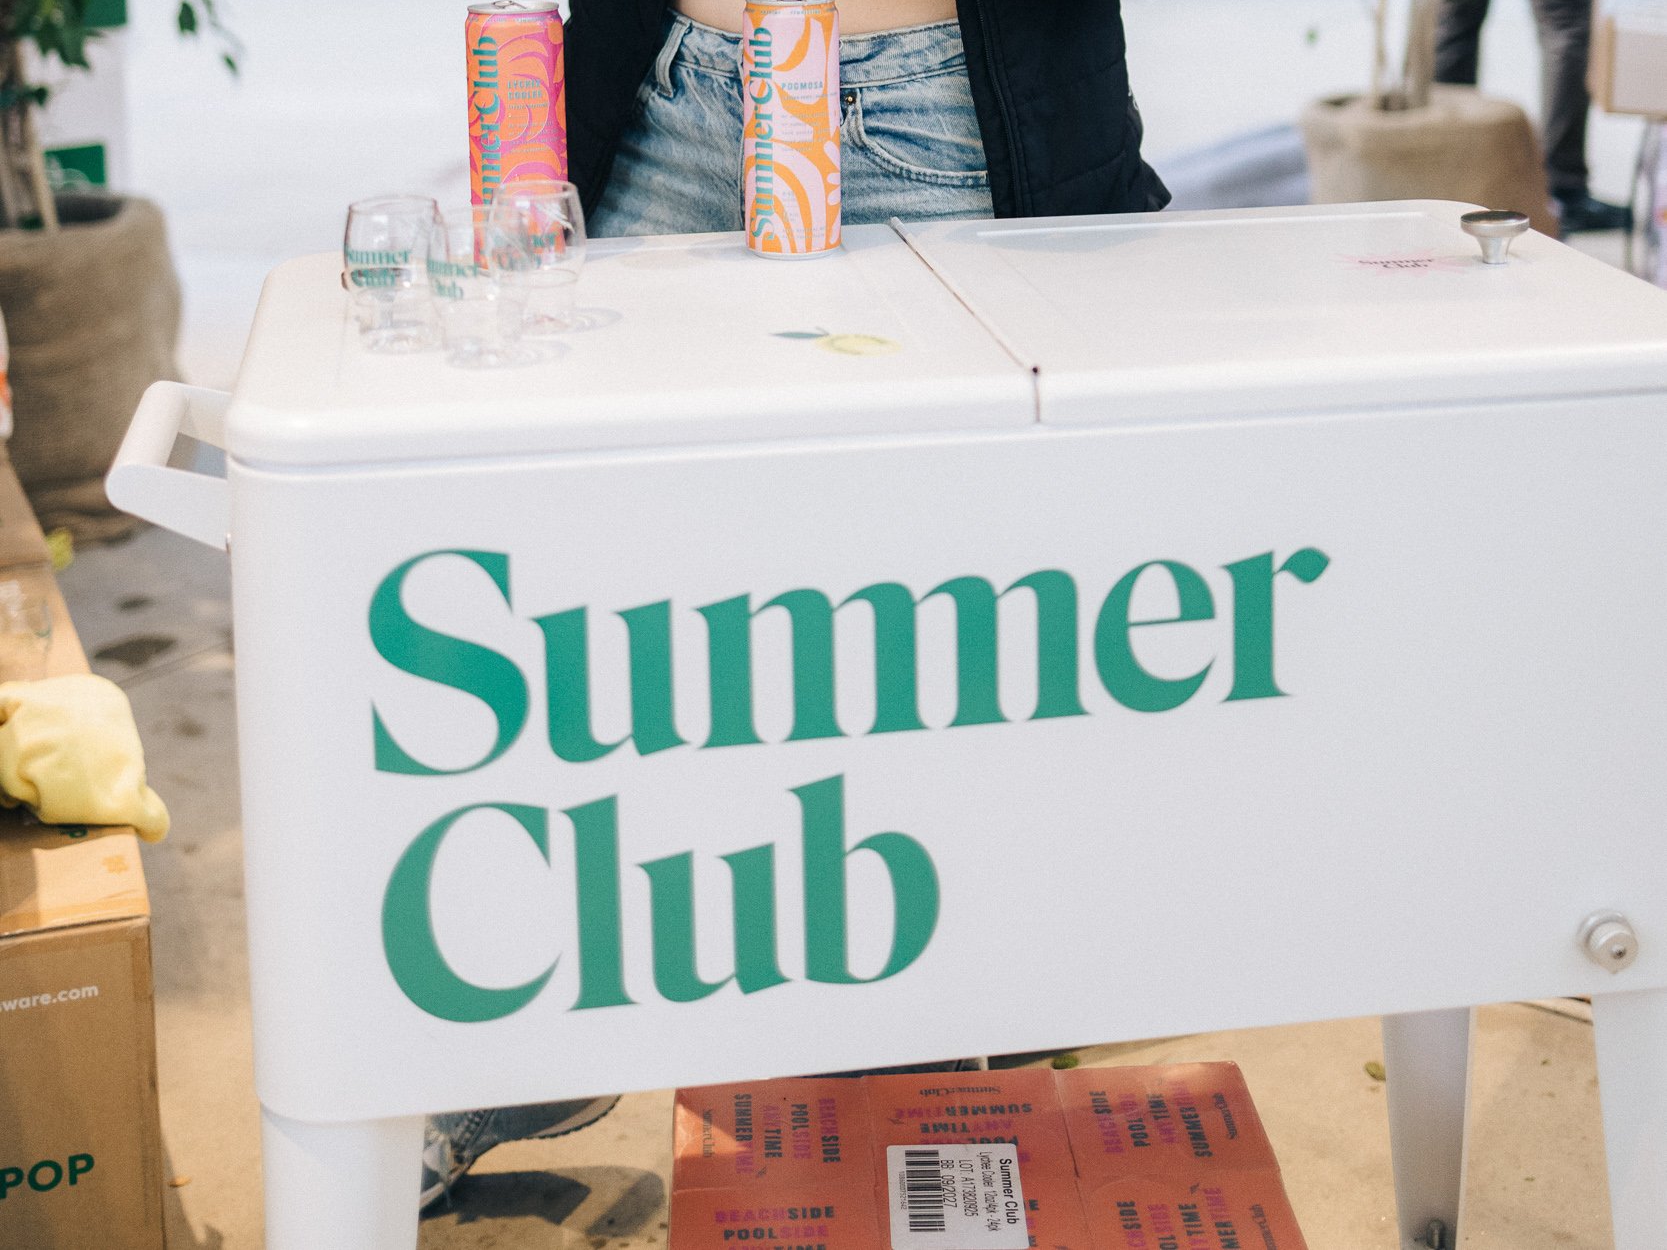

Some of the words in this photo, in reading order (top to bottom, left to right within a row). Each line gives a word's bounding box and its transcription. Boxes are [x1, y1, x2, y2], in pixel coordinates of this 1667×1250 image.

[780, 81, 824, 91] POGMOSA
[368, 546, 1331, 777] Summer
[381, 773, 941, 1024] Club
[0, 1153, 94, 1199] POP
[976, 1151, 993, 1170] Lychee
[982, 1170, 996, 1187] Cooler
[999, 1158, 1014, 1198] Summer
[941, 1175, 957, 1208] 09/2027
[1004, 1201, 1020, 1225] Club
[1116, 1200, 1147, 1250] CHSIDE
[1148, 1203, 1178, 1250] OLSIDE
